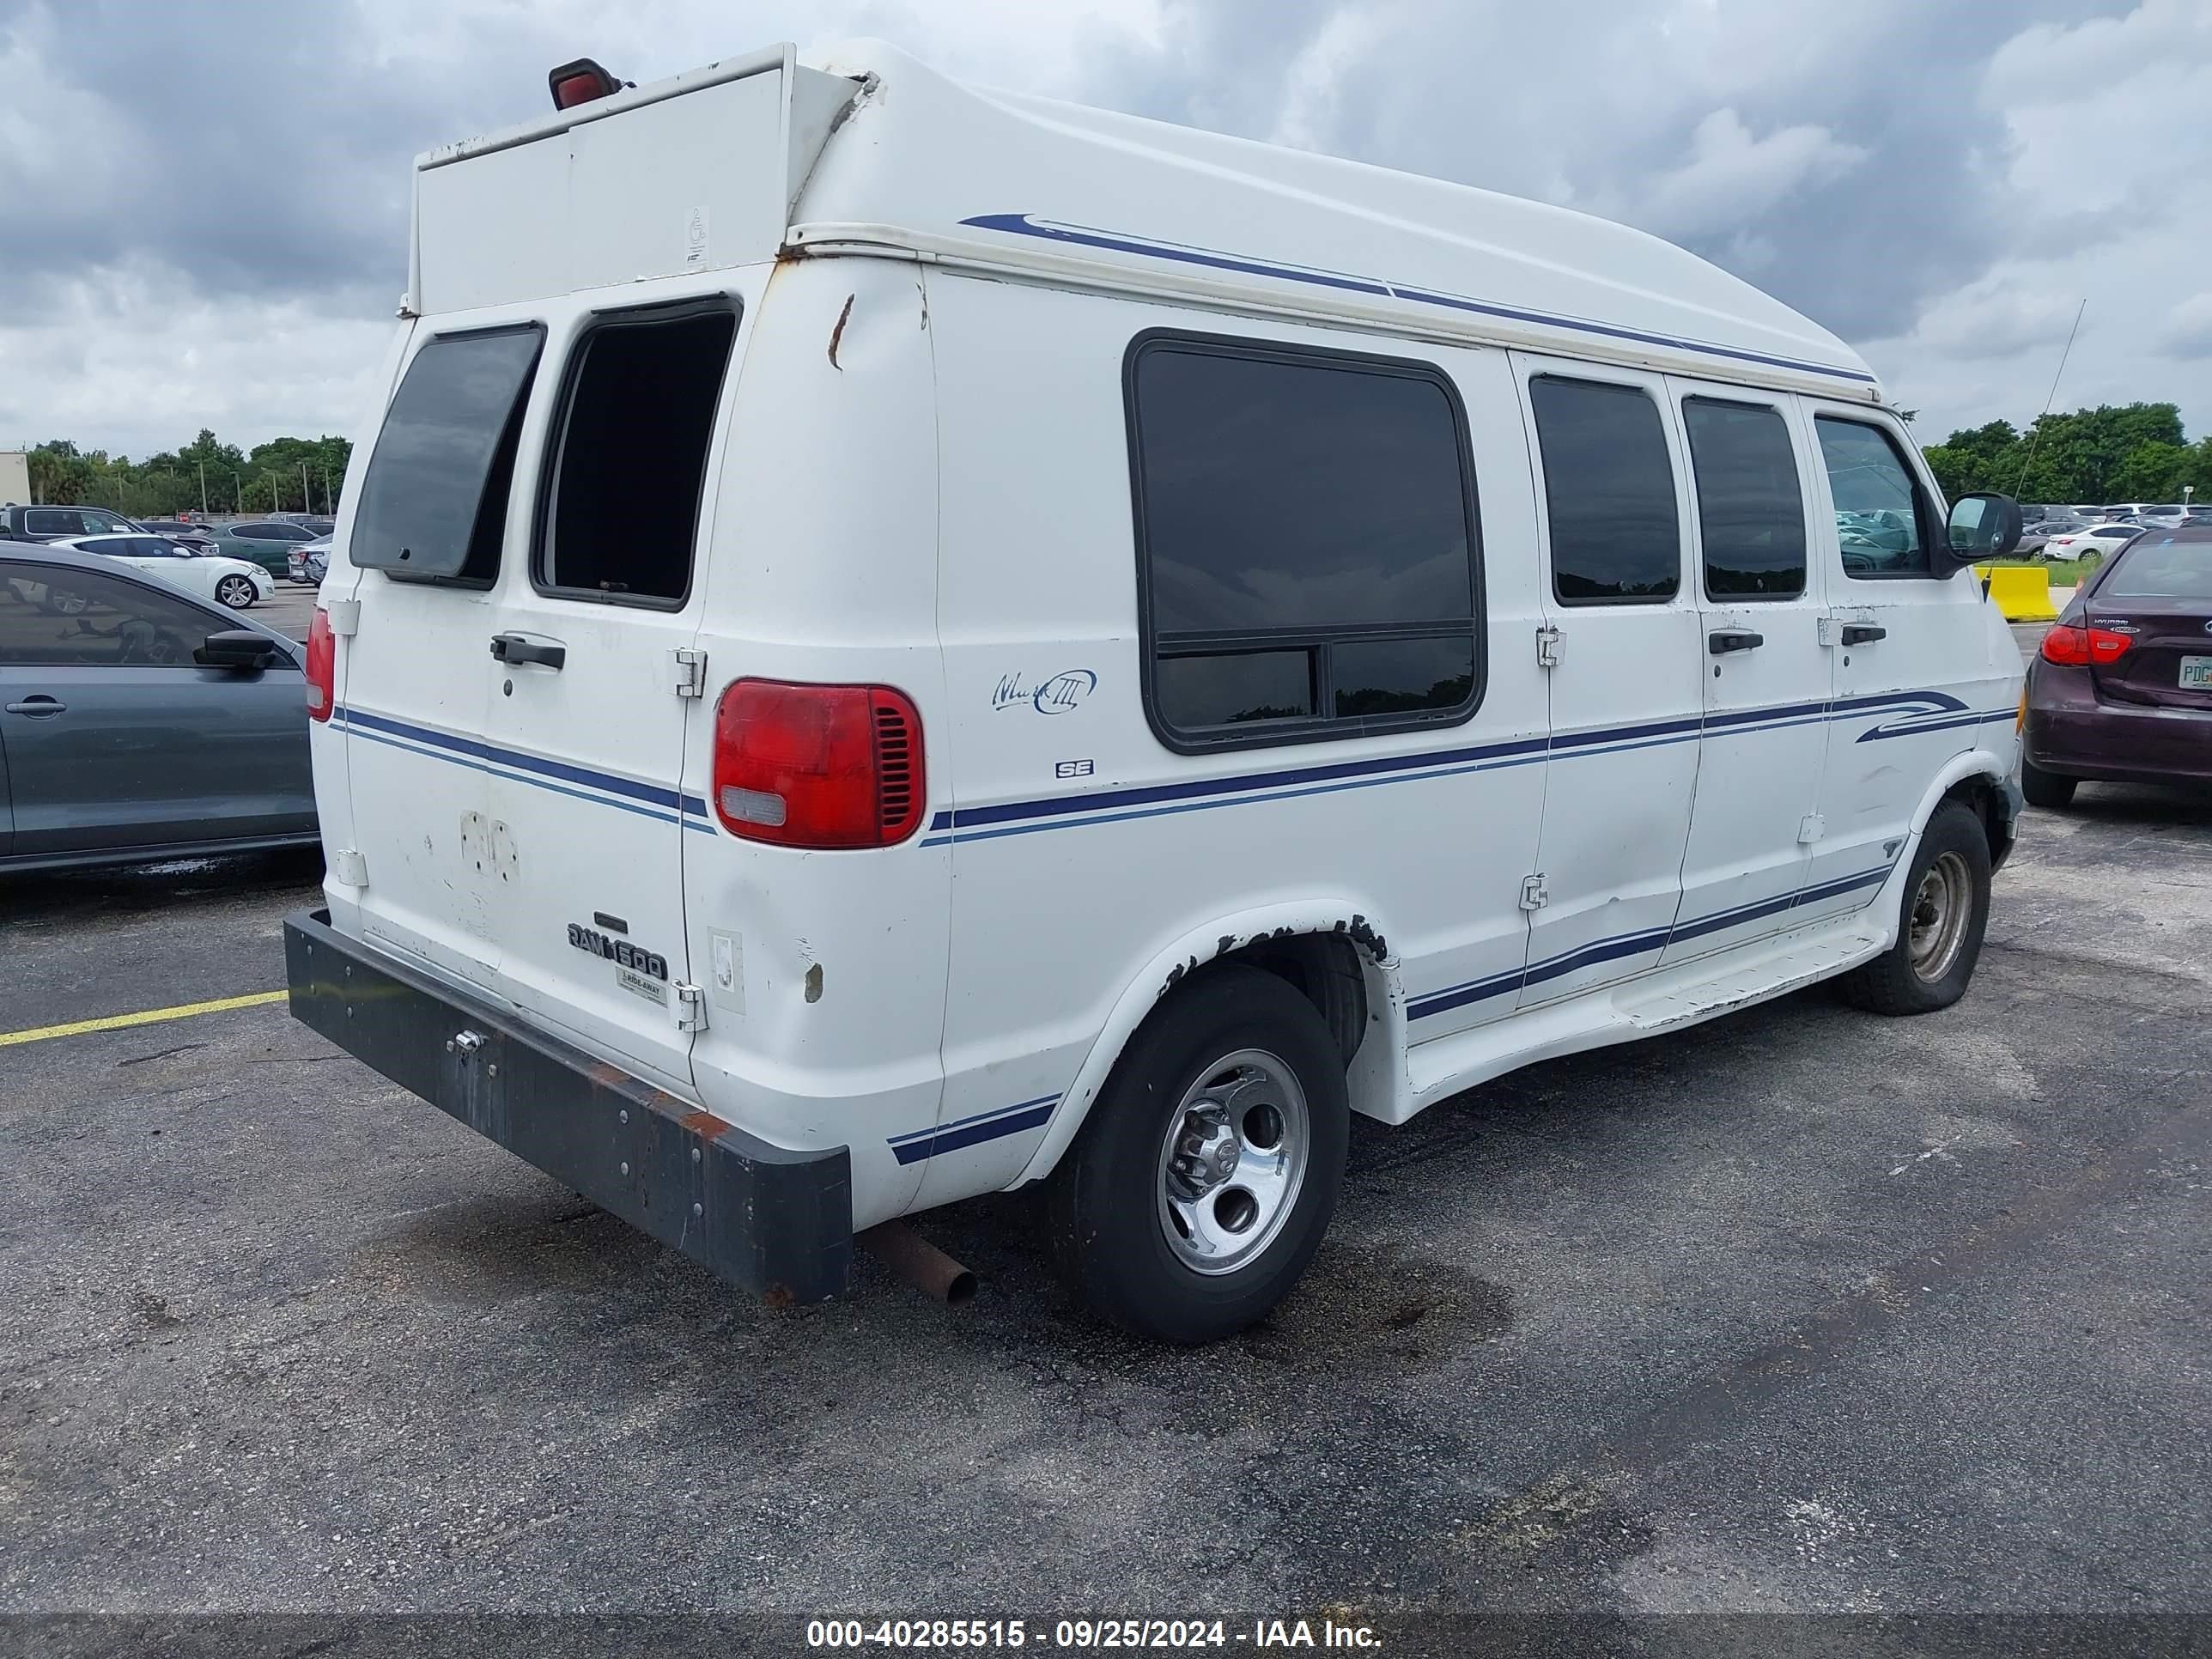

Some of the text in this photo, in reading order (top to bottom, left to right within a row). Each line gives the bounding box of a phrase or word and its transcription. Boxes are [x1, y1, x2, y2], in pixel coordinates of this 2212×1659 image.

[1057, 760, 1092, 778] SE
[567, 923, 668, 981] RAM 1500
